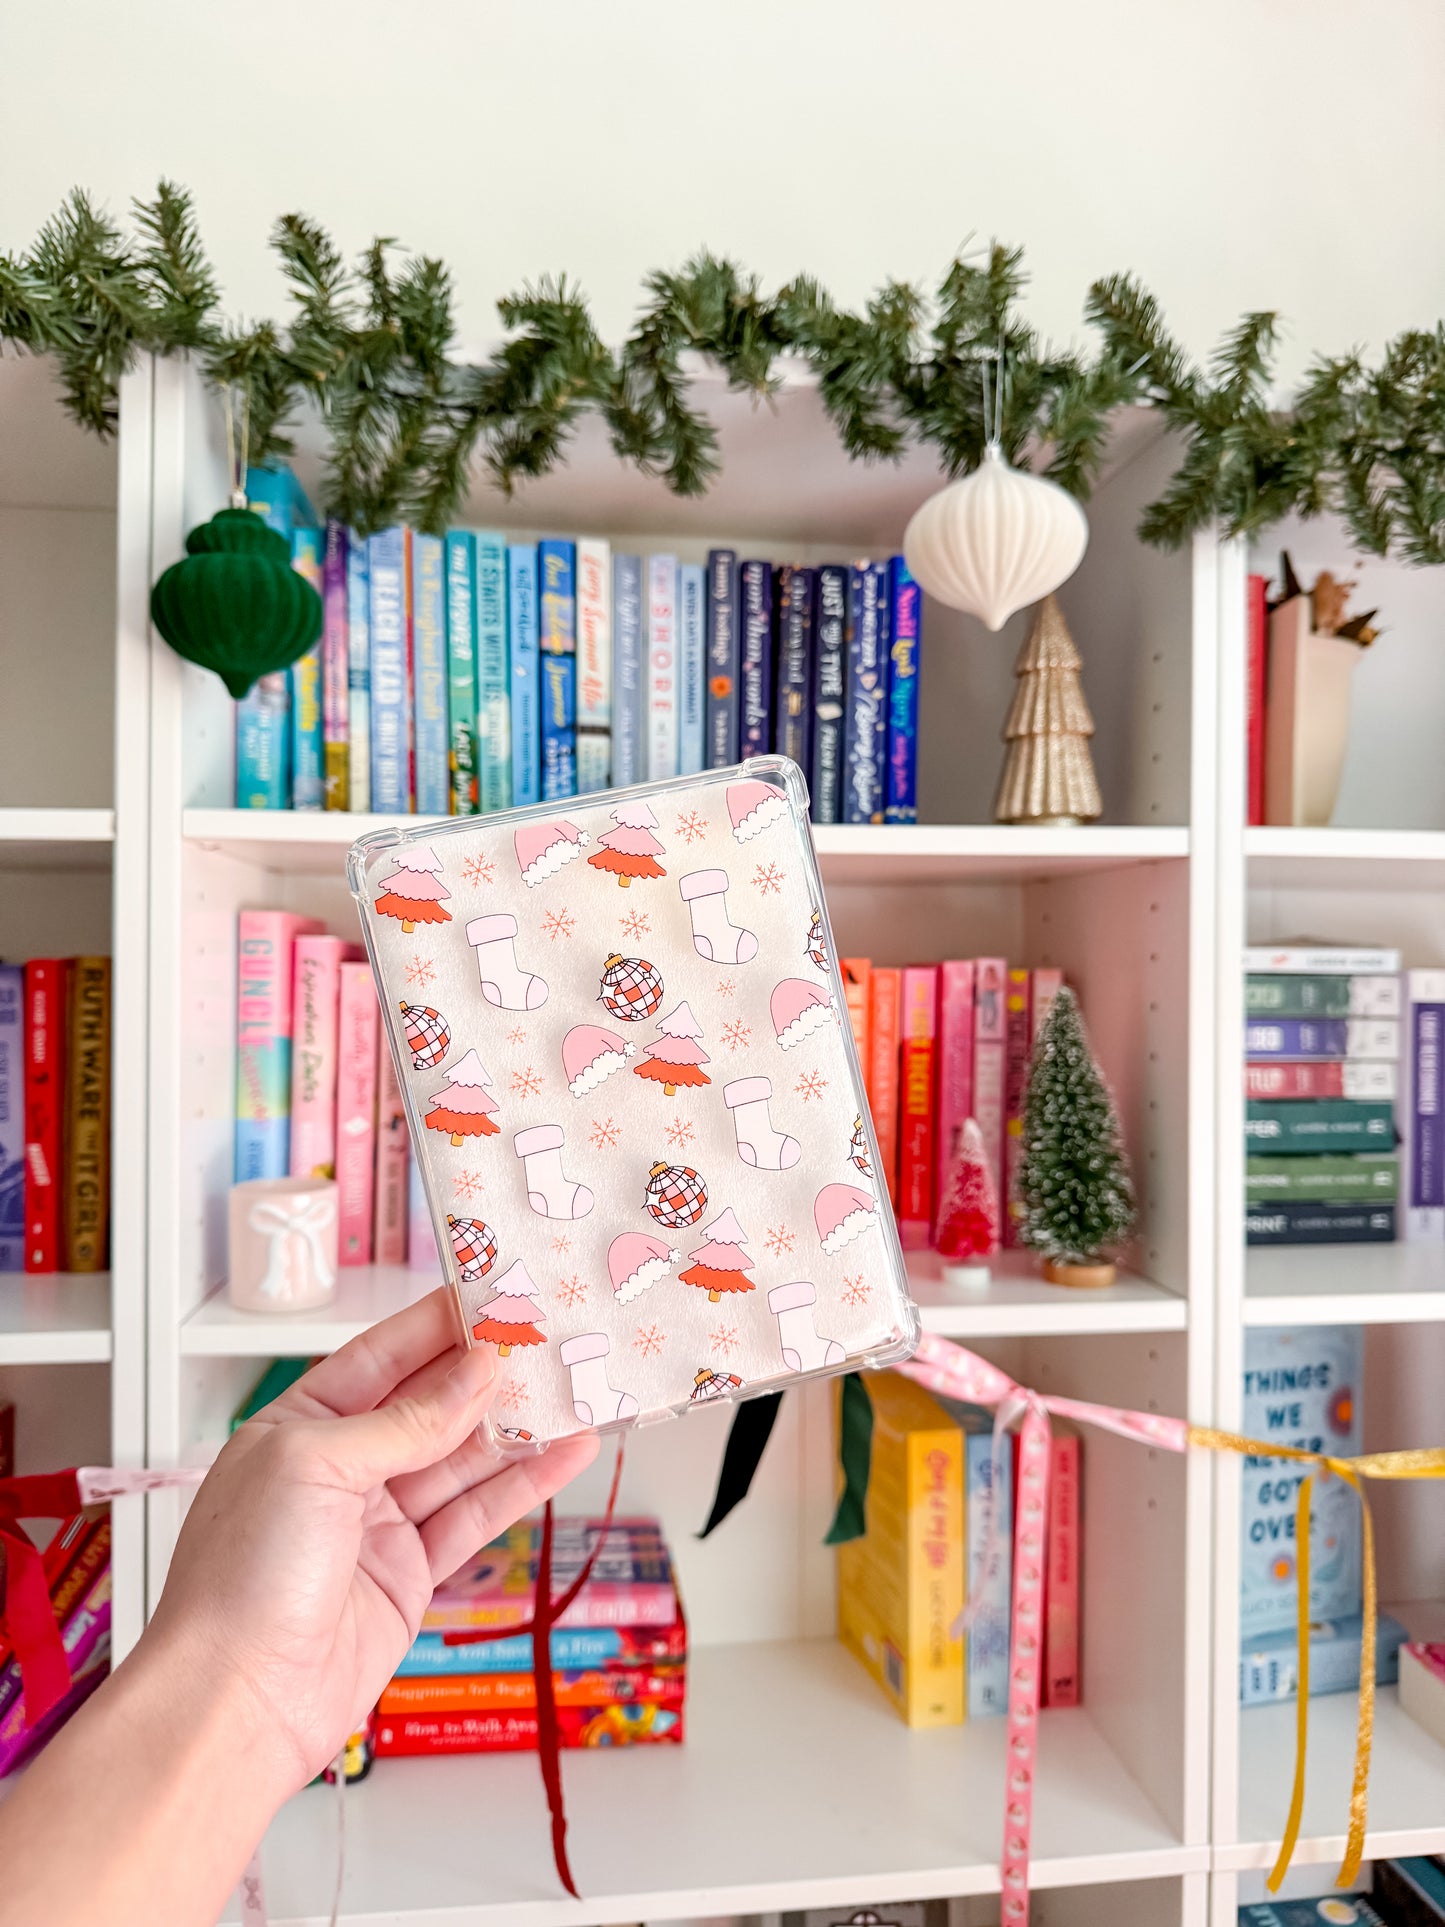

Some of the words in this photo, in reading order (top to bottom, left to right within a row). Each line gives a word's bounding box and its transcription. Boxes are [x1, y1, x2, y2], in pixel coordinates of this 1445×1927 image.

[374, 569, 401, 643] BEACH
[482, 568, 501, 624] STARTS
[747, 562, 764, 614] more
[819, 569, 845, 619] JUST
[483, 633, 502, 677] WITH
[747, 616, 770, 663] than
[374, 647, 401, 706] READ
[746, 668, 768, 727] words
[820, 652, 843, 697] TYPE
[81, 969, 105, 1048] RUTH
[239, 938, 274, 1053] GUNCLE
[79, 1048, 103, 1121] WARE
[78, 1153, 101, 1178] IT
[77, 1179, 100, 1236] GIRL
[1243, 1362, 1330, 1395] THINGS
[1265, 1402, 1302, 1430] WE
